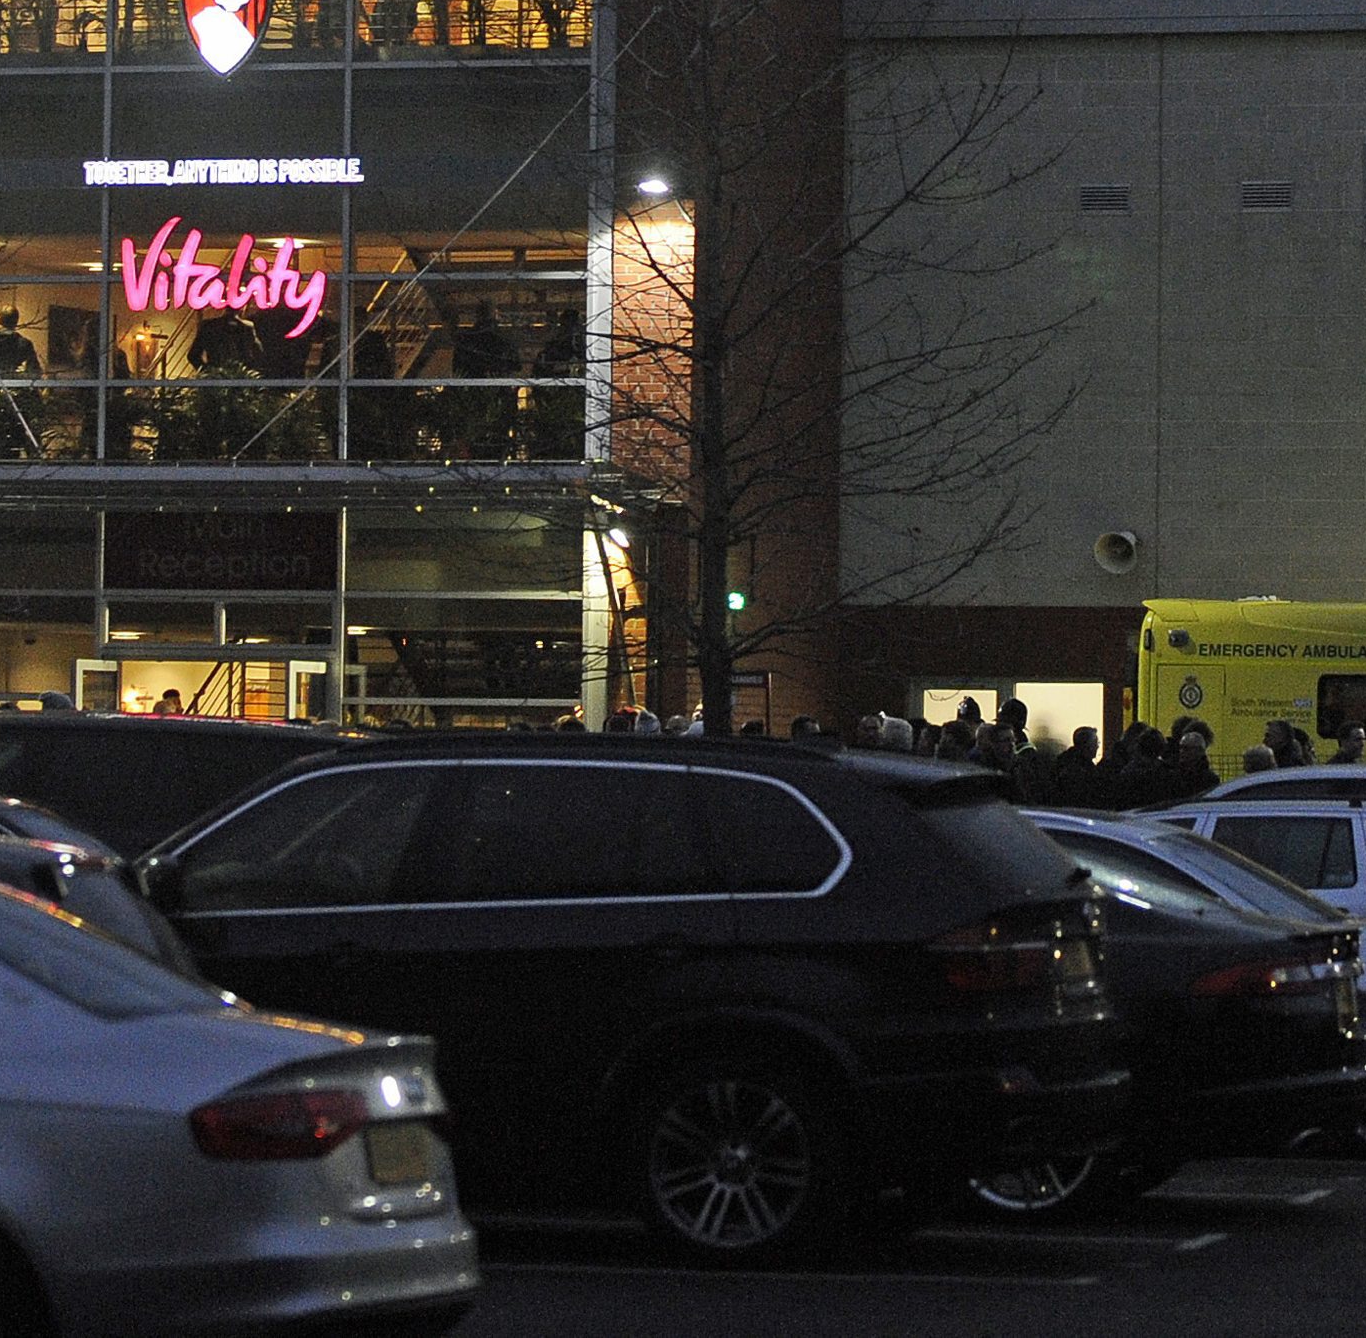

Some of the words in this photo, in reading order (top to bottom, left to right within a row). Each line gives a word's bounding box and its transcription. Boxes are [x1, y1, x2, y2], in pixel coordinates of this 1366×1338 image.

[173, 159, 259, 184] ANYTHING
[259, 159, 278, 183] IS
[121, 216, 326, 339] Vitality
[139, 549, 312, 581] Reception
[1198, 643, 1299, 658] EMERGENCY
